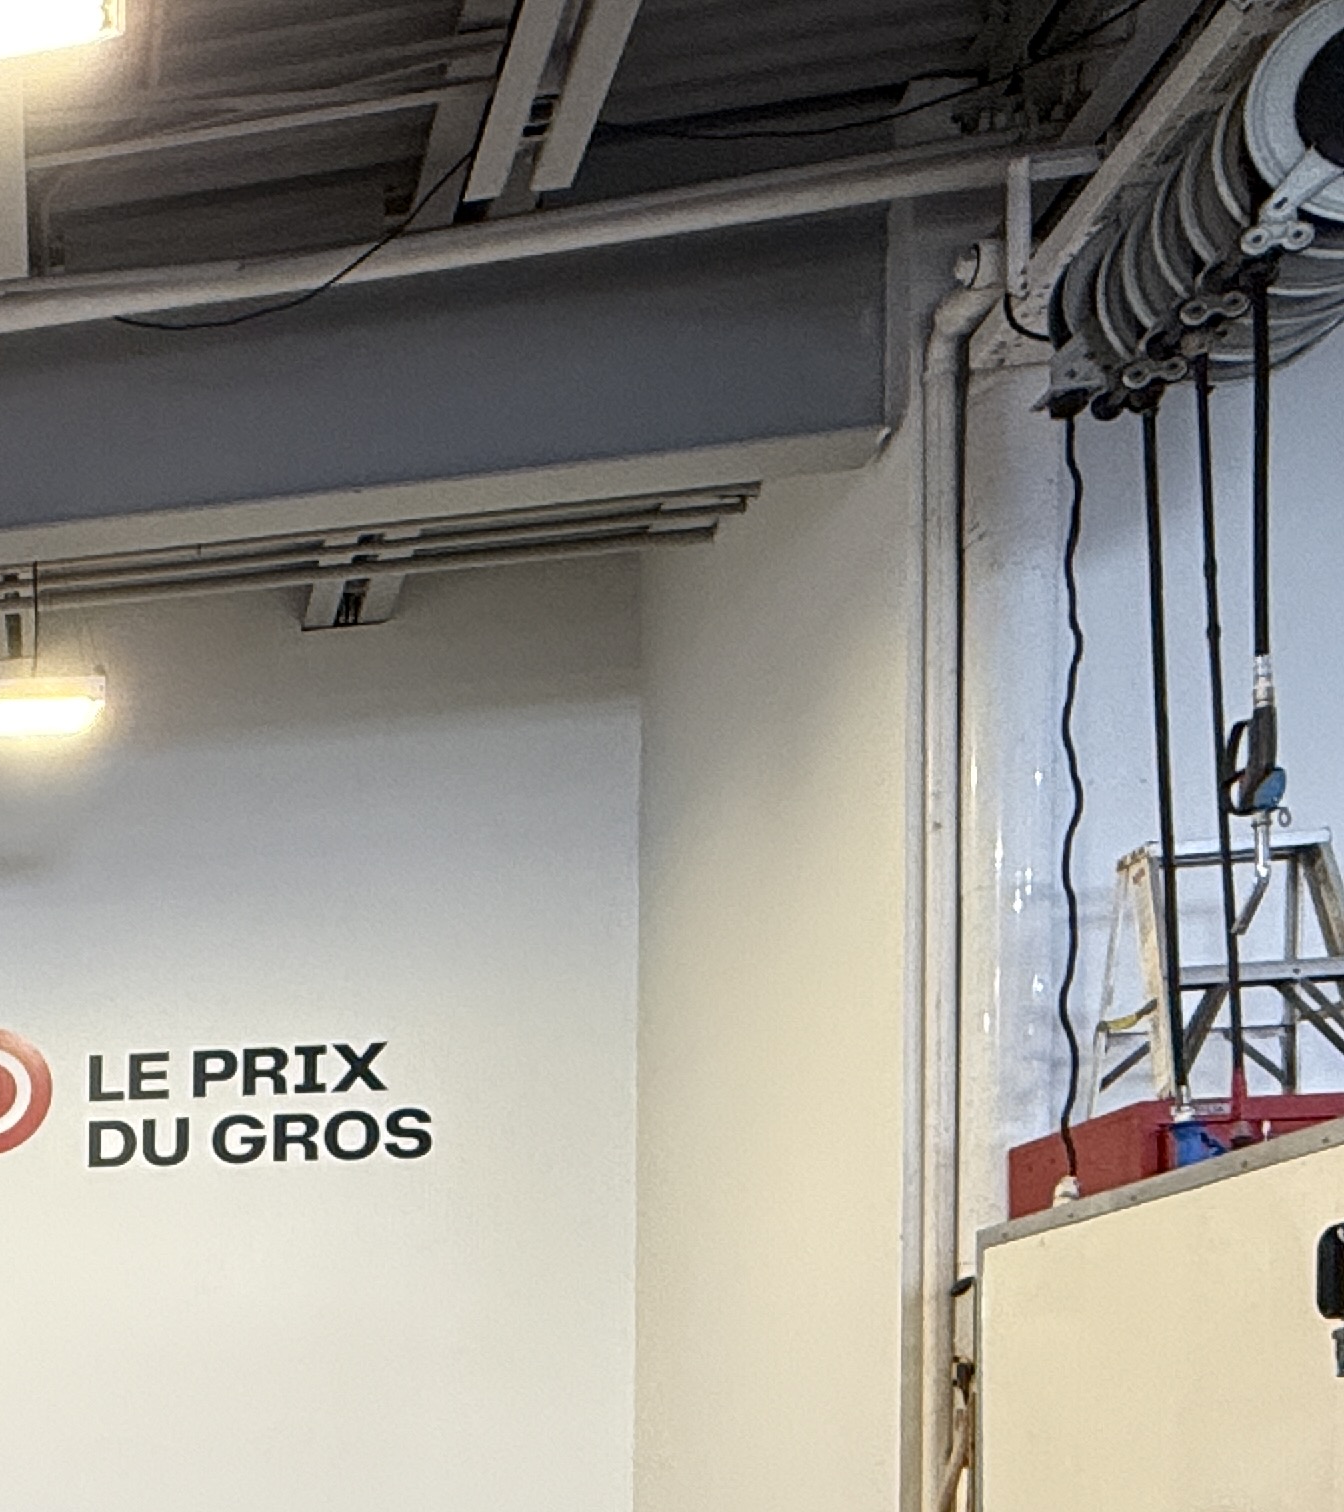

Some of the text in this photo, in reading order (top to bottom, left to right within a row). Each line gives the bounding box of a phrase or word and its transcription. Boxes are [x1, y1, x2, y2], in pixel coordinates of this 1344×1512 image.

[88, 1041, 388, 1101] LE PRIX
[88, 1108, 432, 1167] DU GROS
